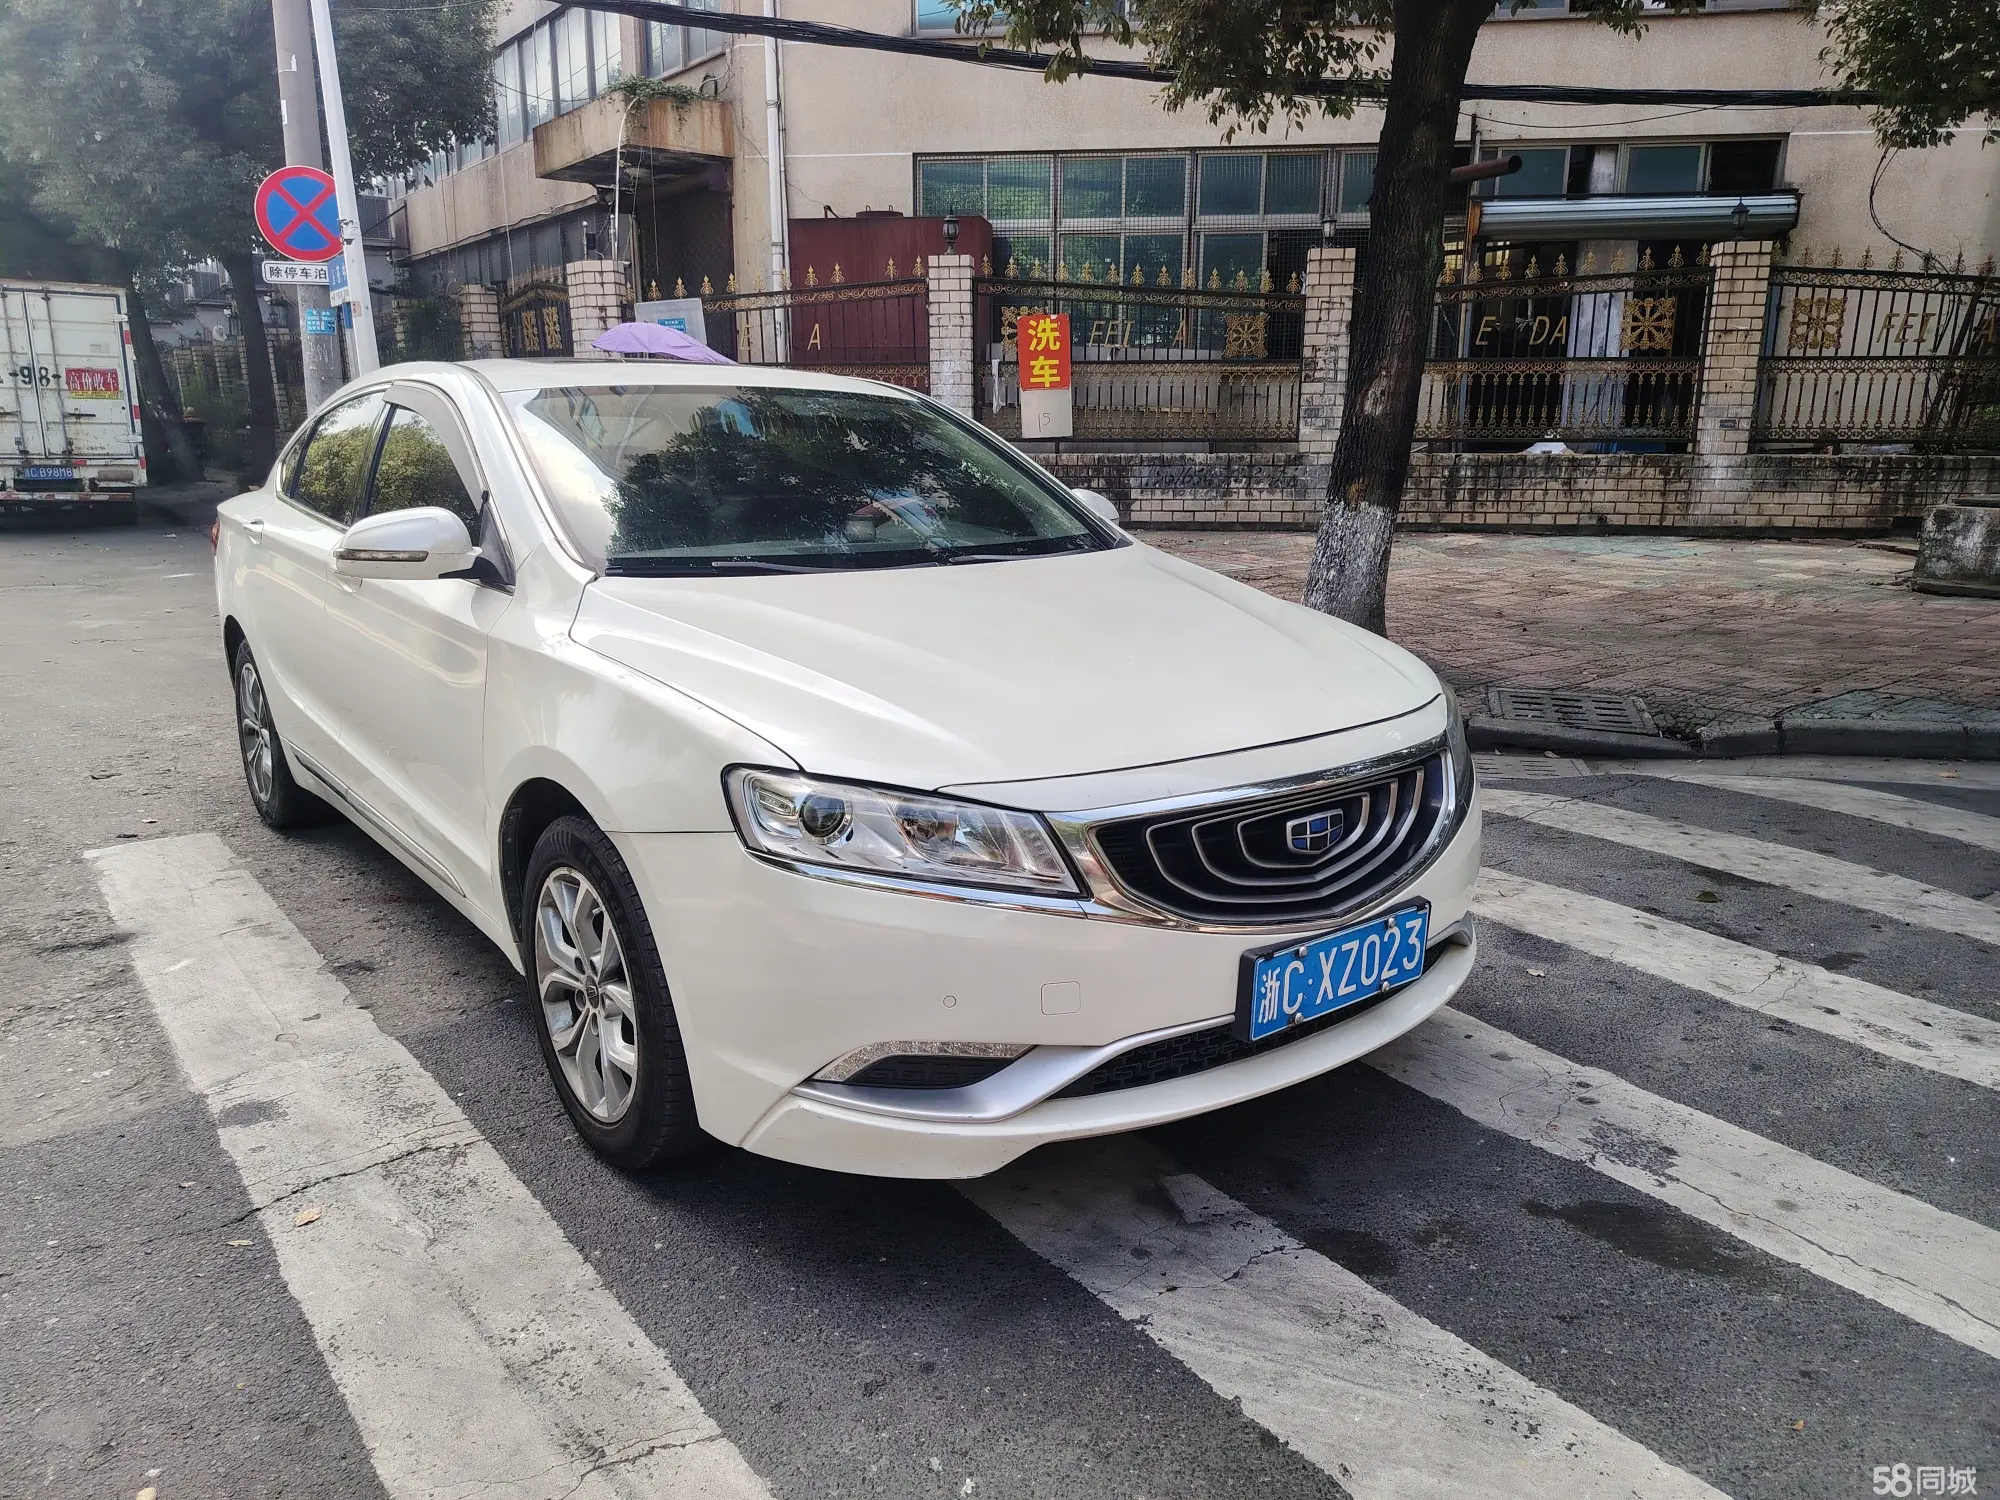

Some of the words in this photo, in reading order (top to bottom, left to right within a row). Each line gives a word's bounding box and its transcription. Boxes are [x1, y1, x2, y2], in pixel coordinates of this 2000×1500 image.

[270, 266, 327, 280] 除停车泊
[1529, 316, 1567, 345] DA
[1028, 318, 1061, 388] 洗车
